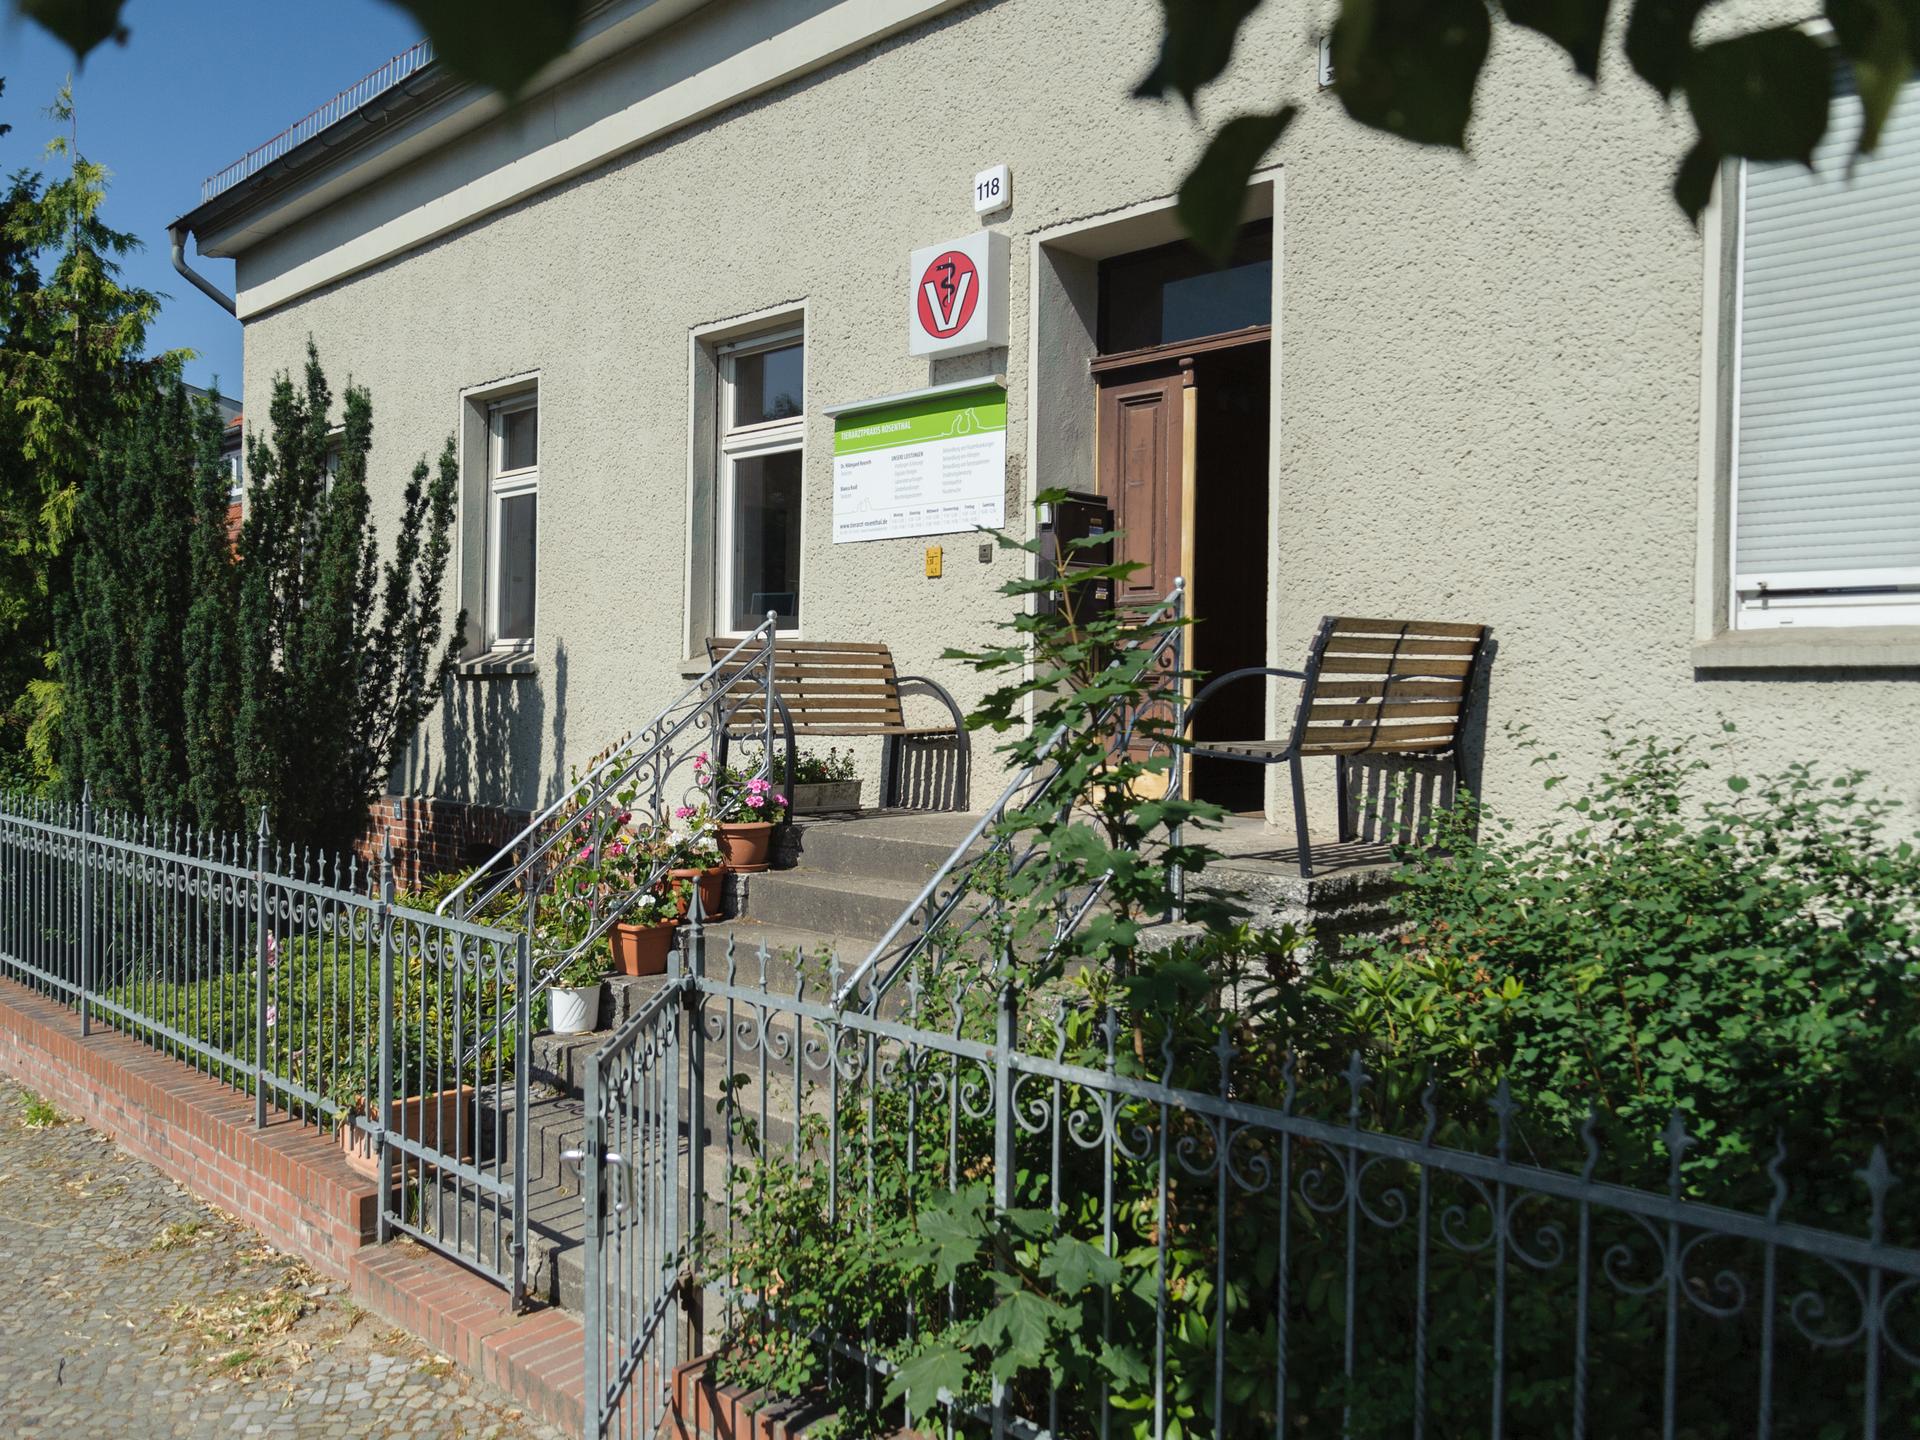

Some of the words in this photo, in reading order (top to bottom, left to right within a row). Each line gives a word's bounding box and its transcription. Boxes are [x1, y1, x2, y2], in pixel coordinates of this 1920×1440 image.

[976, 177, 1000, 201] 118
[923, 270, 973, 333] V
[841, 426, 881, 440] TIERARZTPRAXIS
[882, 420, 911, 434] ROSENTHAL
